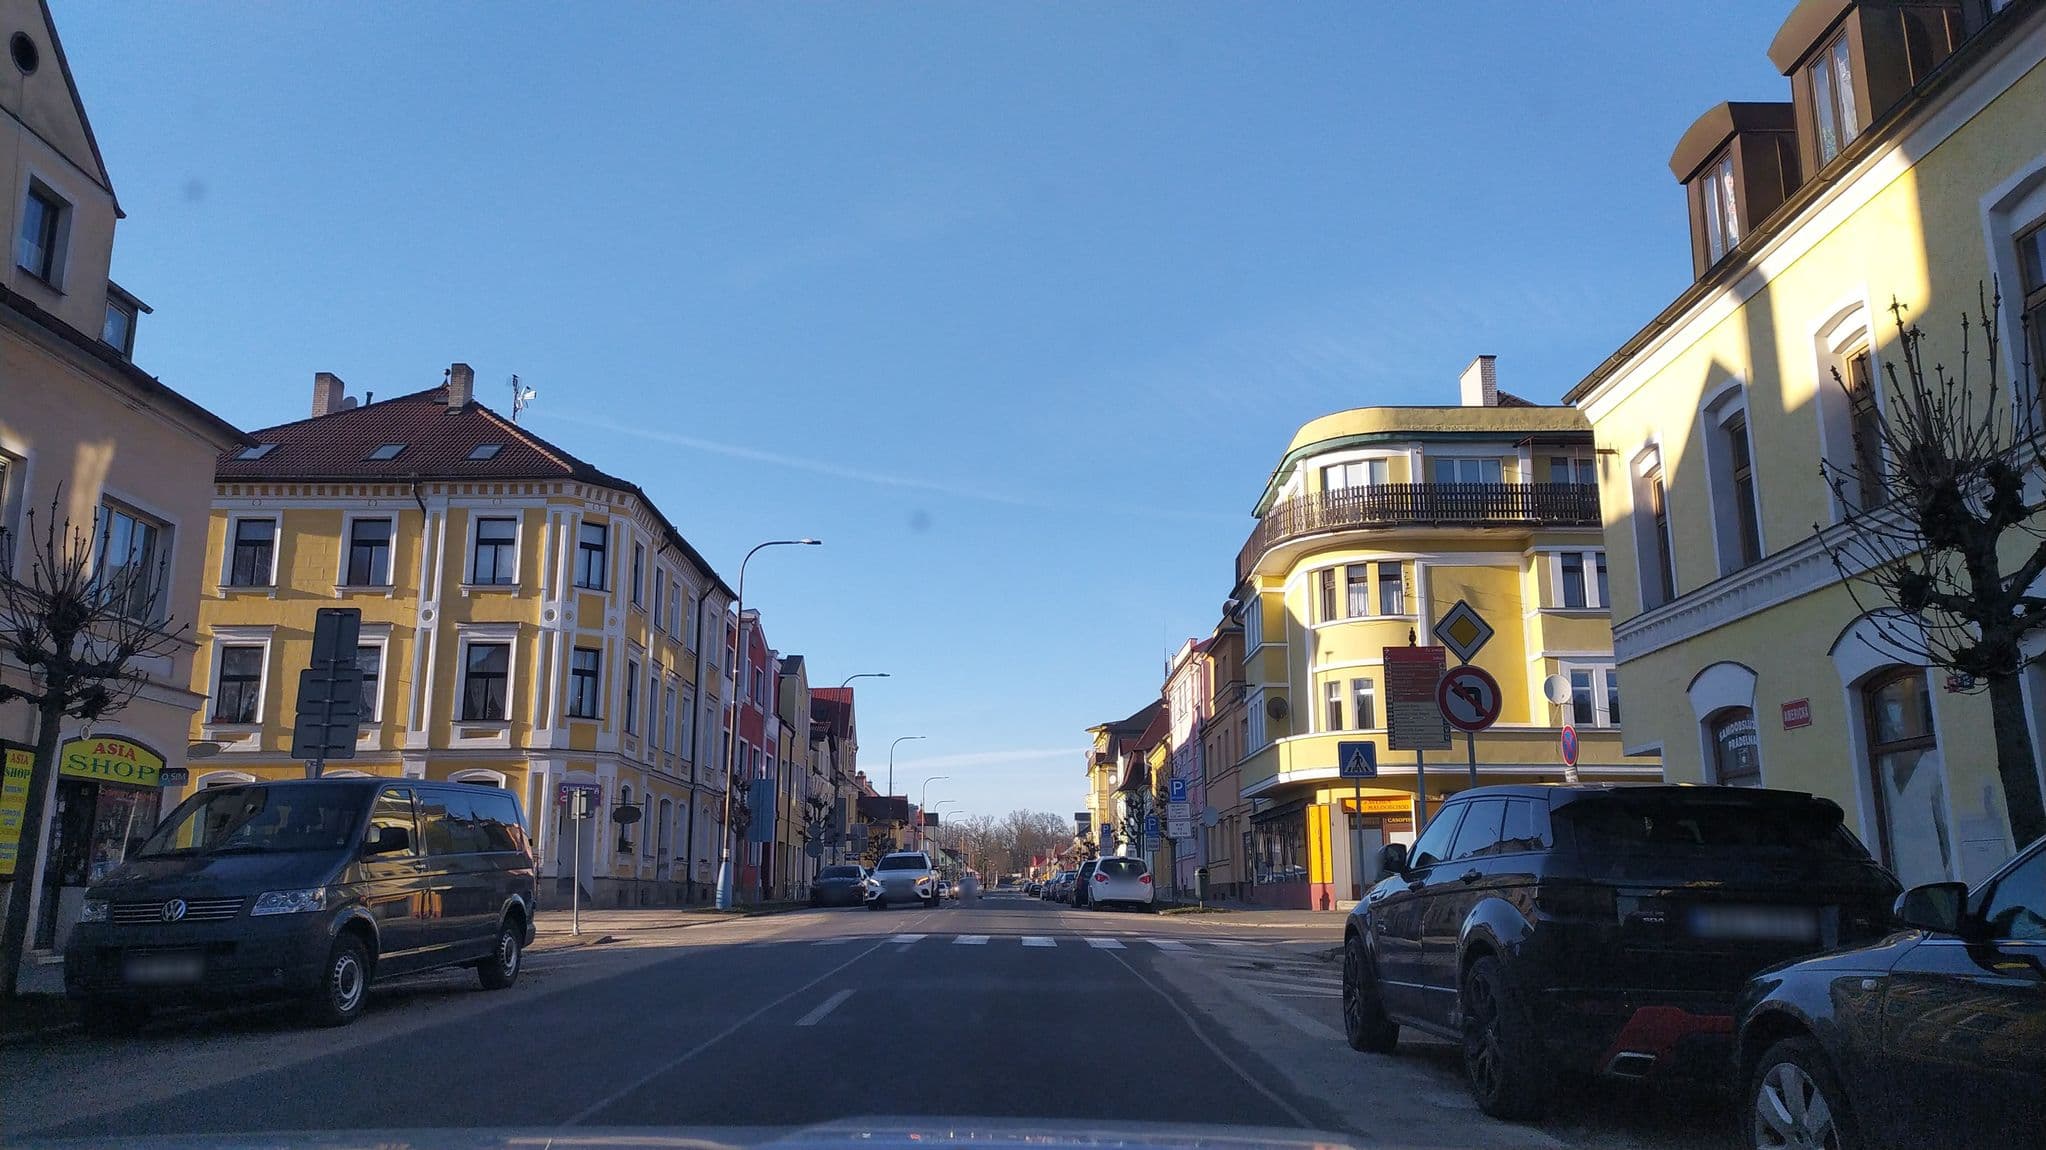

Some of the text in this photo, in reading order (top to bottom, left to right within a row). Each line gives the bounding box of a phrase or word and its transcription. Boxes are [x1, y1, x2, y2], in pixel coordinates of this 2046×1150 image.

[93, 742, 136, 761] ASIA
[10, 753, 29, 765] ASIA
[67, 753, 156, 780] SHOP
[4, 767, 31, 780] SHOP
[1173, 781, 1183, 795] P
[1148, 817, 1156, 830] P
